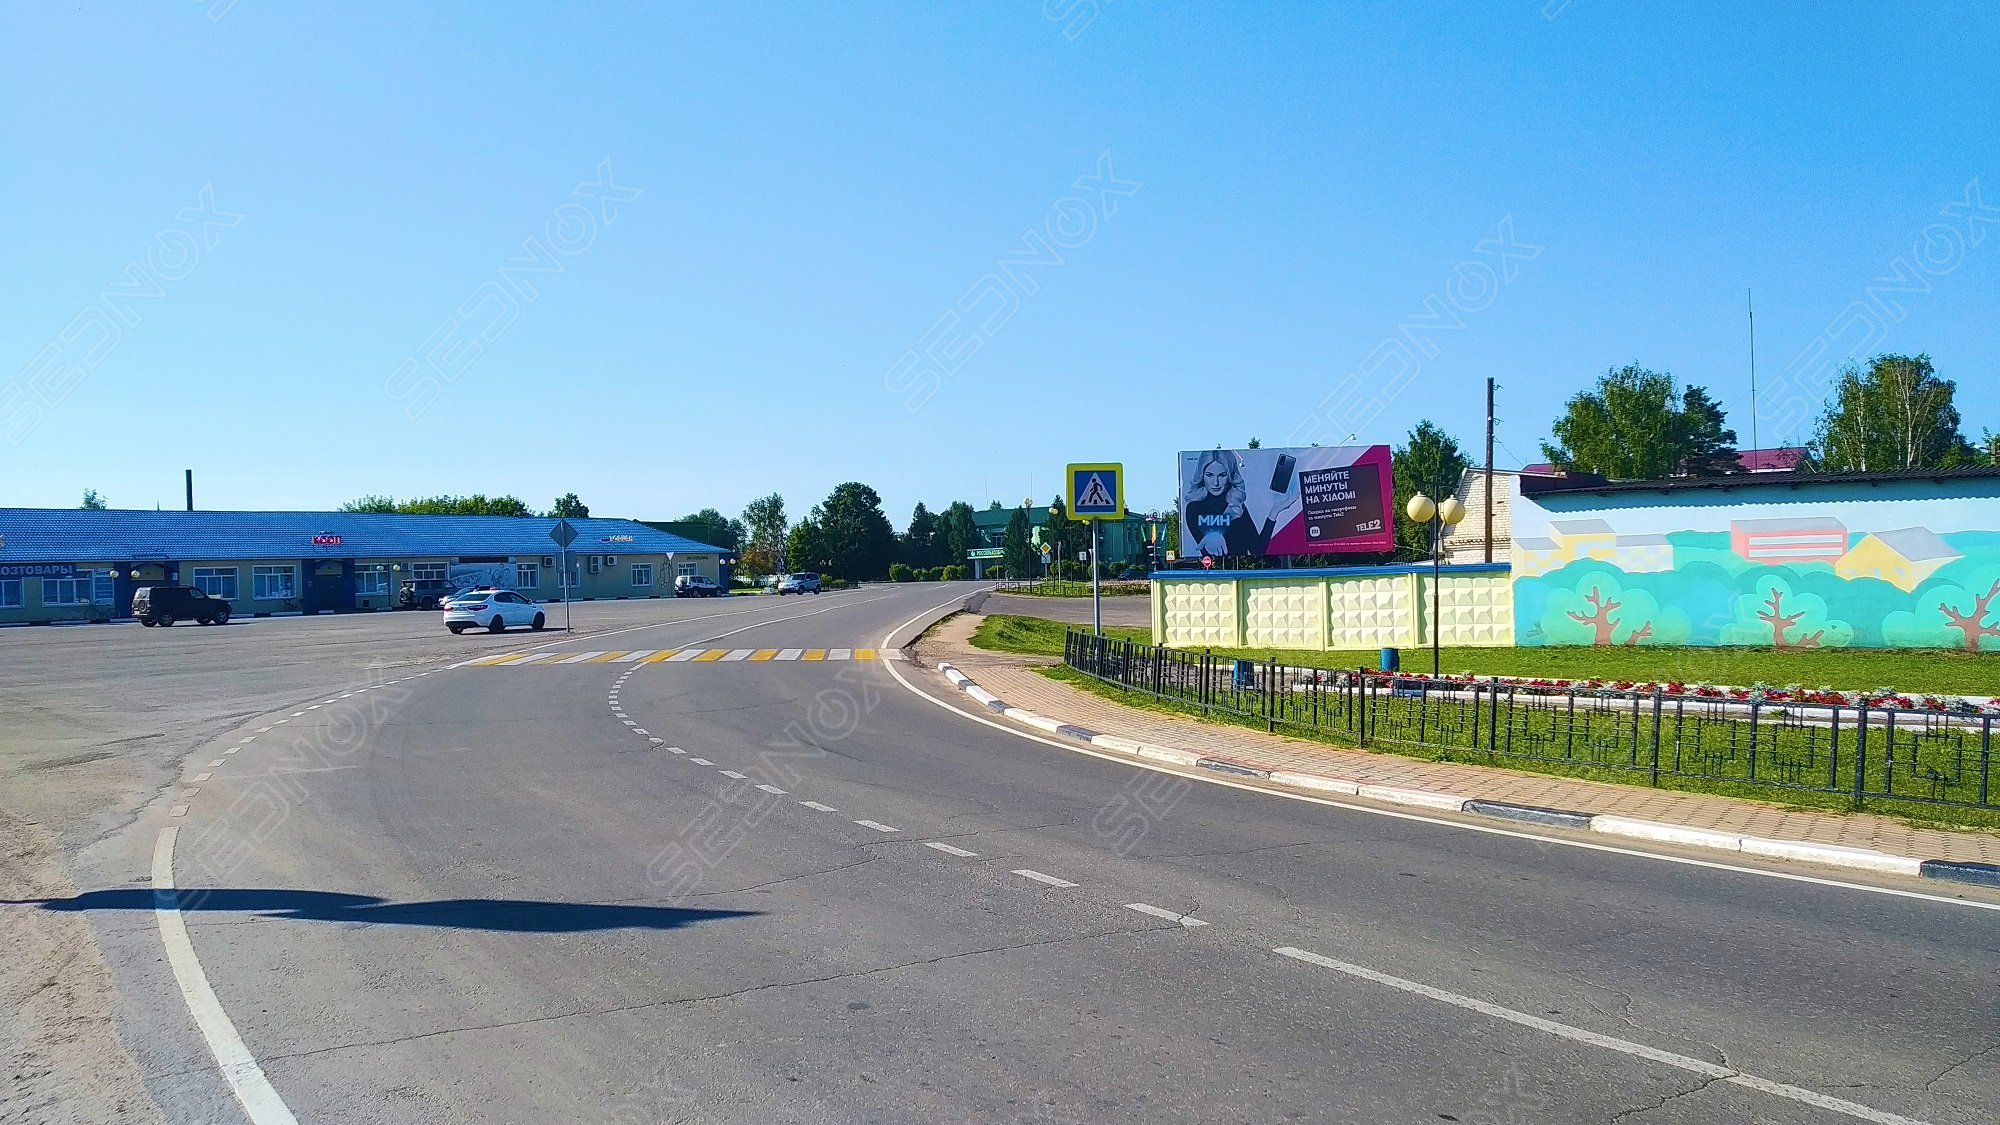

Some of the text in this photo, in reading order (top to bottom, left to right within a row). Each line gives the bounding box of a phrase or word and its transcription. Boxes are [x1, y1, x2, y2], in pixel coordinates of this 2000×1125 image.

[1304, 471, 1349, 484] МЕНЯЙТЕ
[1305, 481, 1348, 494] МИНУТЫ
[1306, 491, 1356, 504] НА XIAOMI
[1198, 514, 1230, 526] МИН
[1356, 519, 1381, 531] TELE2
[0, 565, 73, 576] ОЗТОВАРЫ
